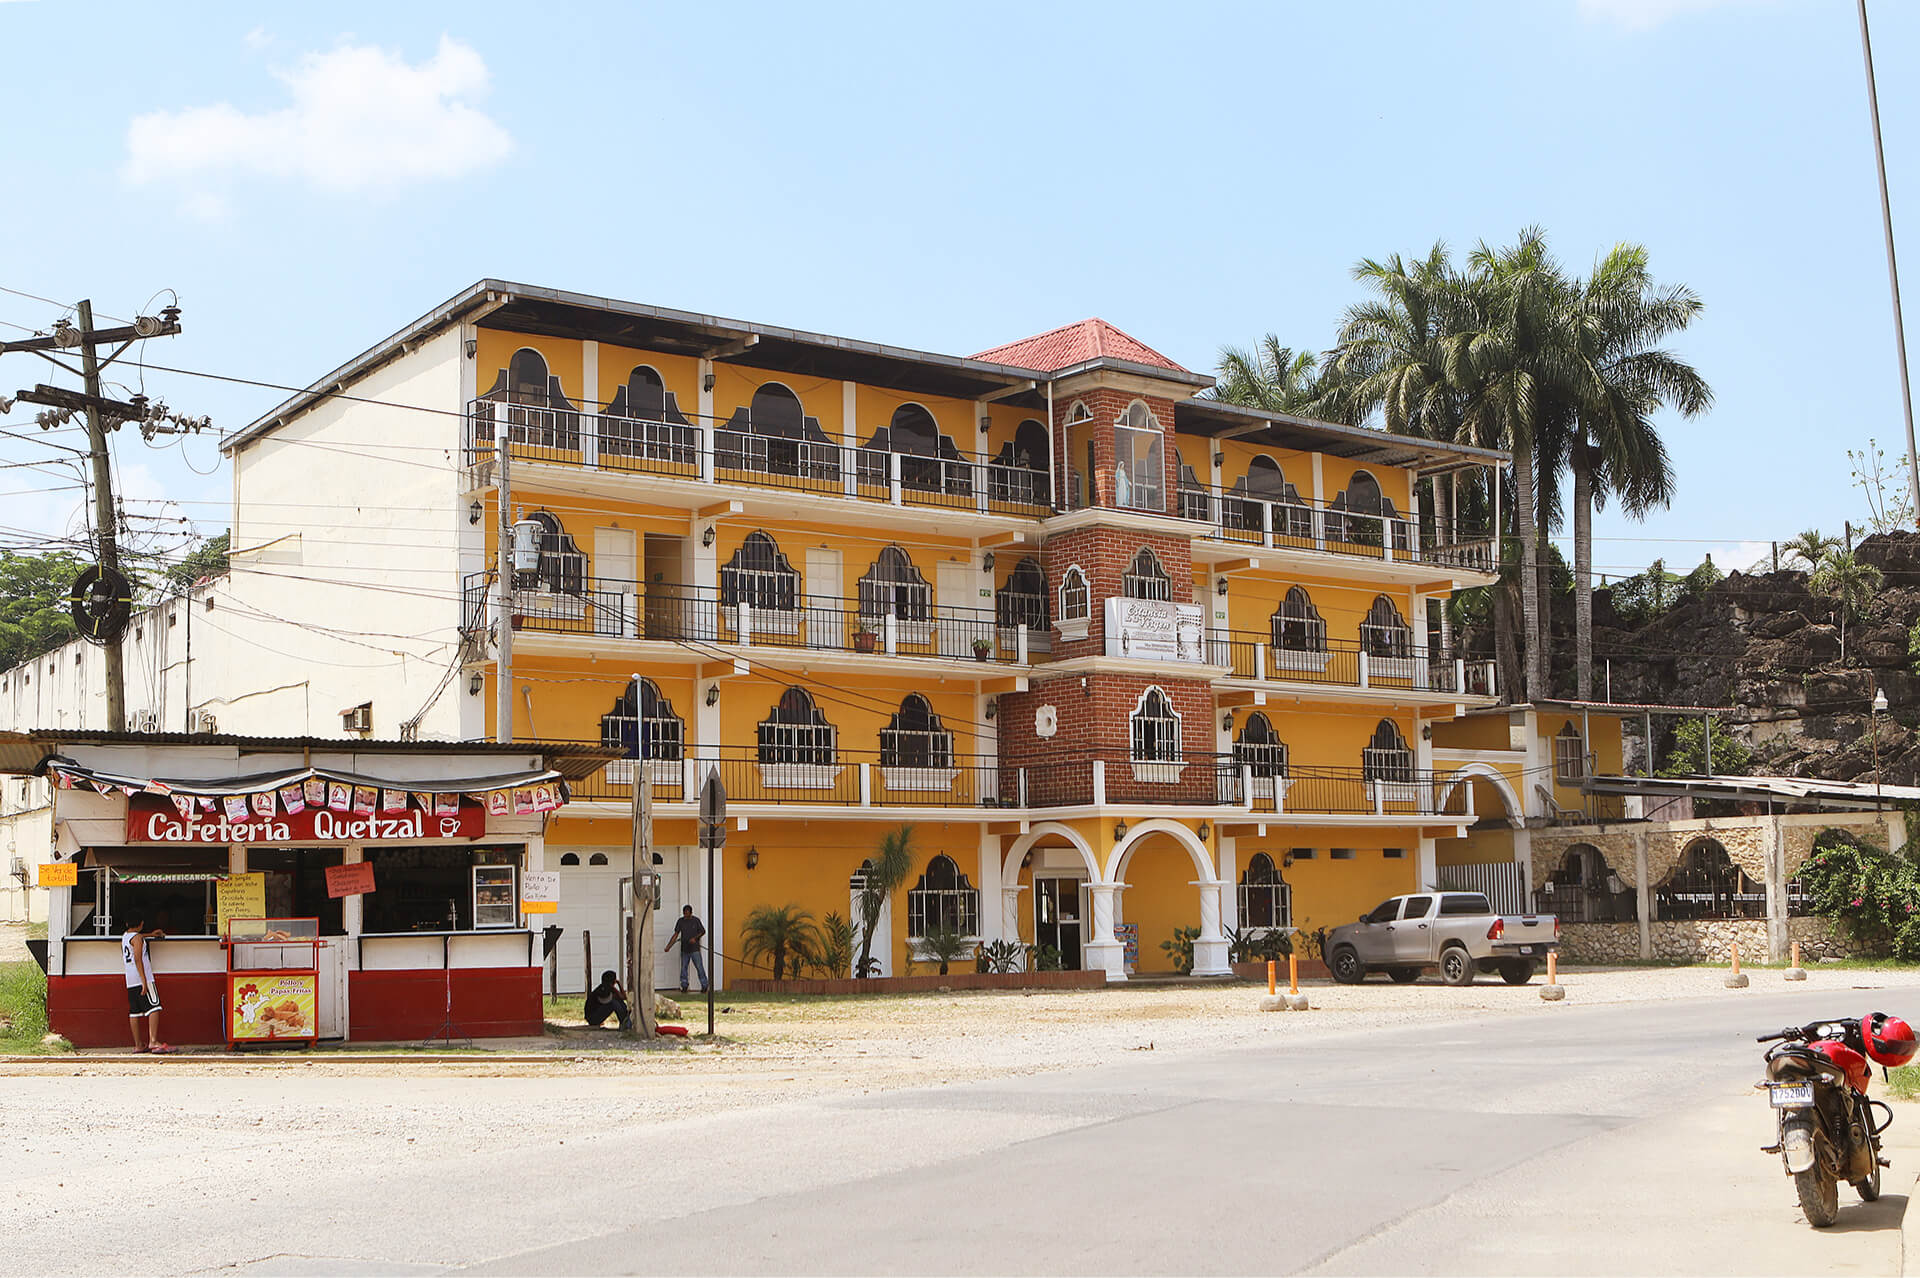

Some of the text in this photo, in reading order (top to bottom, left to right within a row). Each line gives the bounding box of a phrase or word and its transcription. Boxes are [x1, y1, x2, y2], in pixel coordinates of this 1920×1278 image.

[1128, 603, 1168, 619] Estancia
[1140, 615, 1170, 632] Virgen
[314, 809, 424, 839] Quetzal
[137, 873, 211, 882] TACOS MEXICANOS
[525, 873, 545, 882] Venta
[124, 945, 132, 963] 2
[271, 987, 312, 997] Papas Fritas
